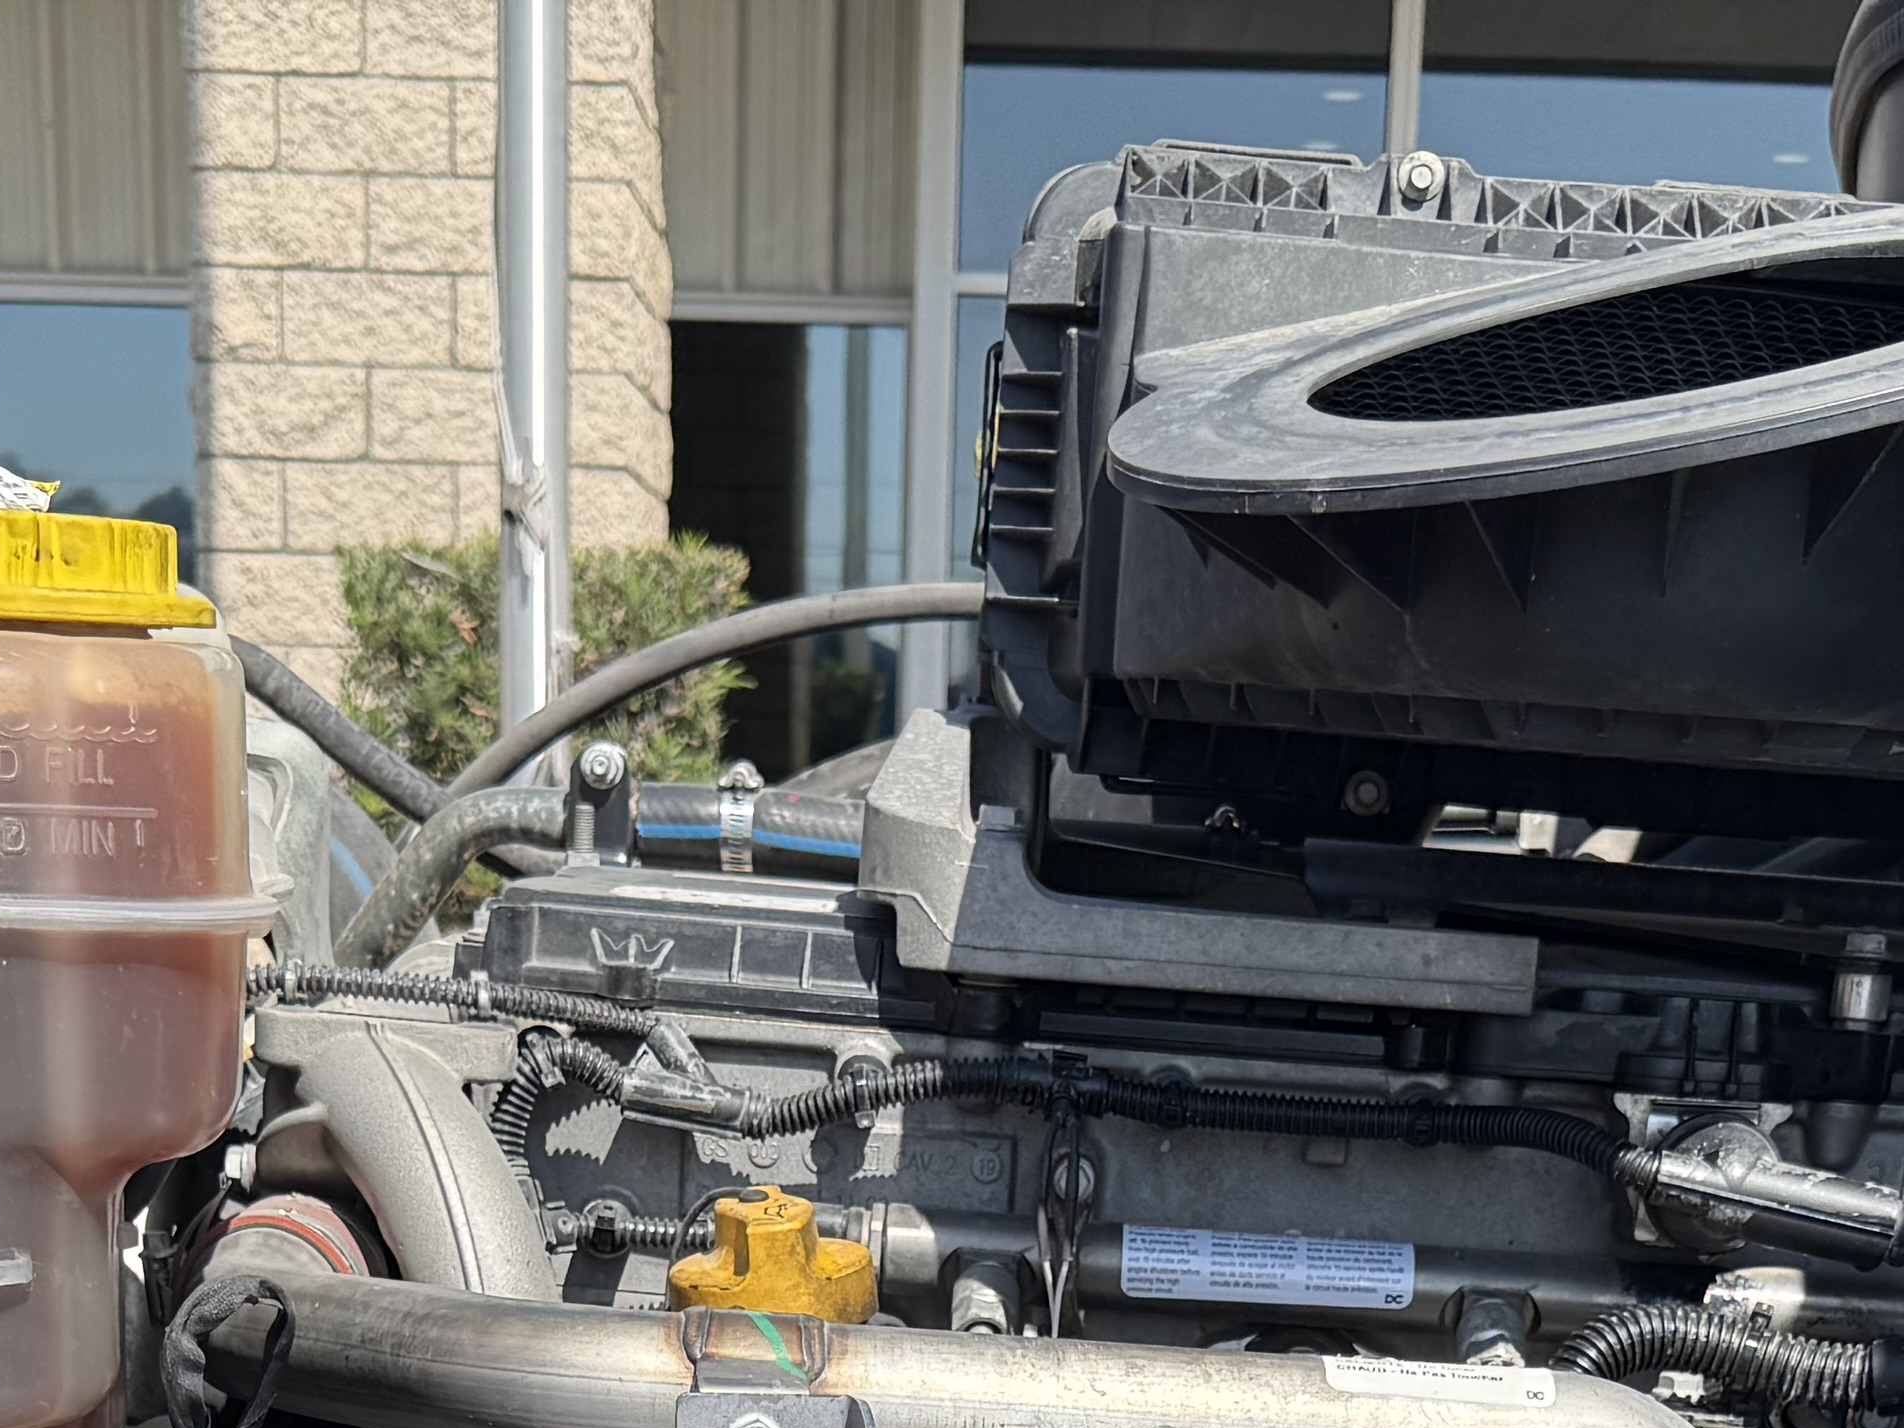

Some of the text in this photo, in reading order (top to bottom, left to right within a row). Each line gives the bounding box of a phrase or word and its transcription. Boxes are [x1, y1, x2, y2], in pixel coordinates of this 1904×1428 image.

[46, 747, 114, 785] FILL
[50, 817, 115, 856] MIN
[1384, 1293, 1403, 1305] DC
[1526, 1390, 1545, 1401] DC
